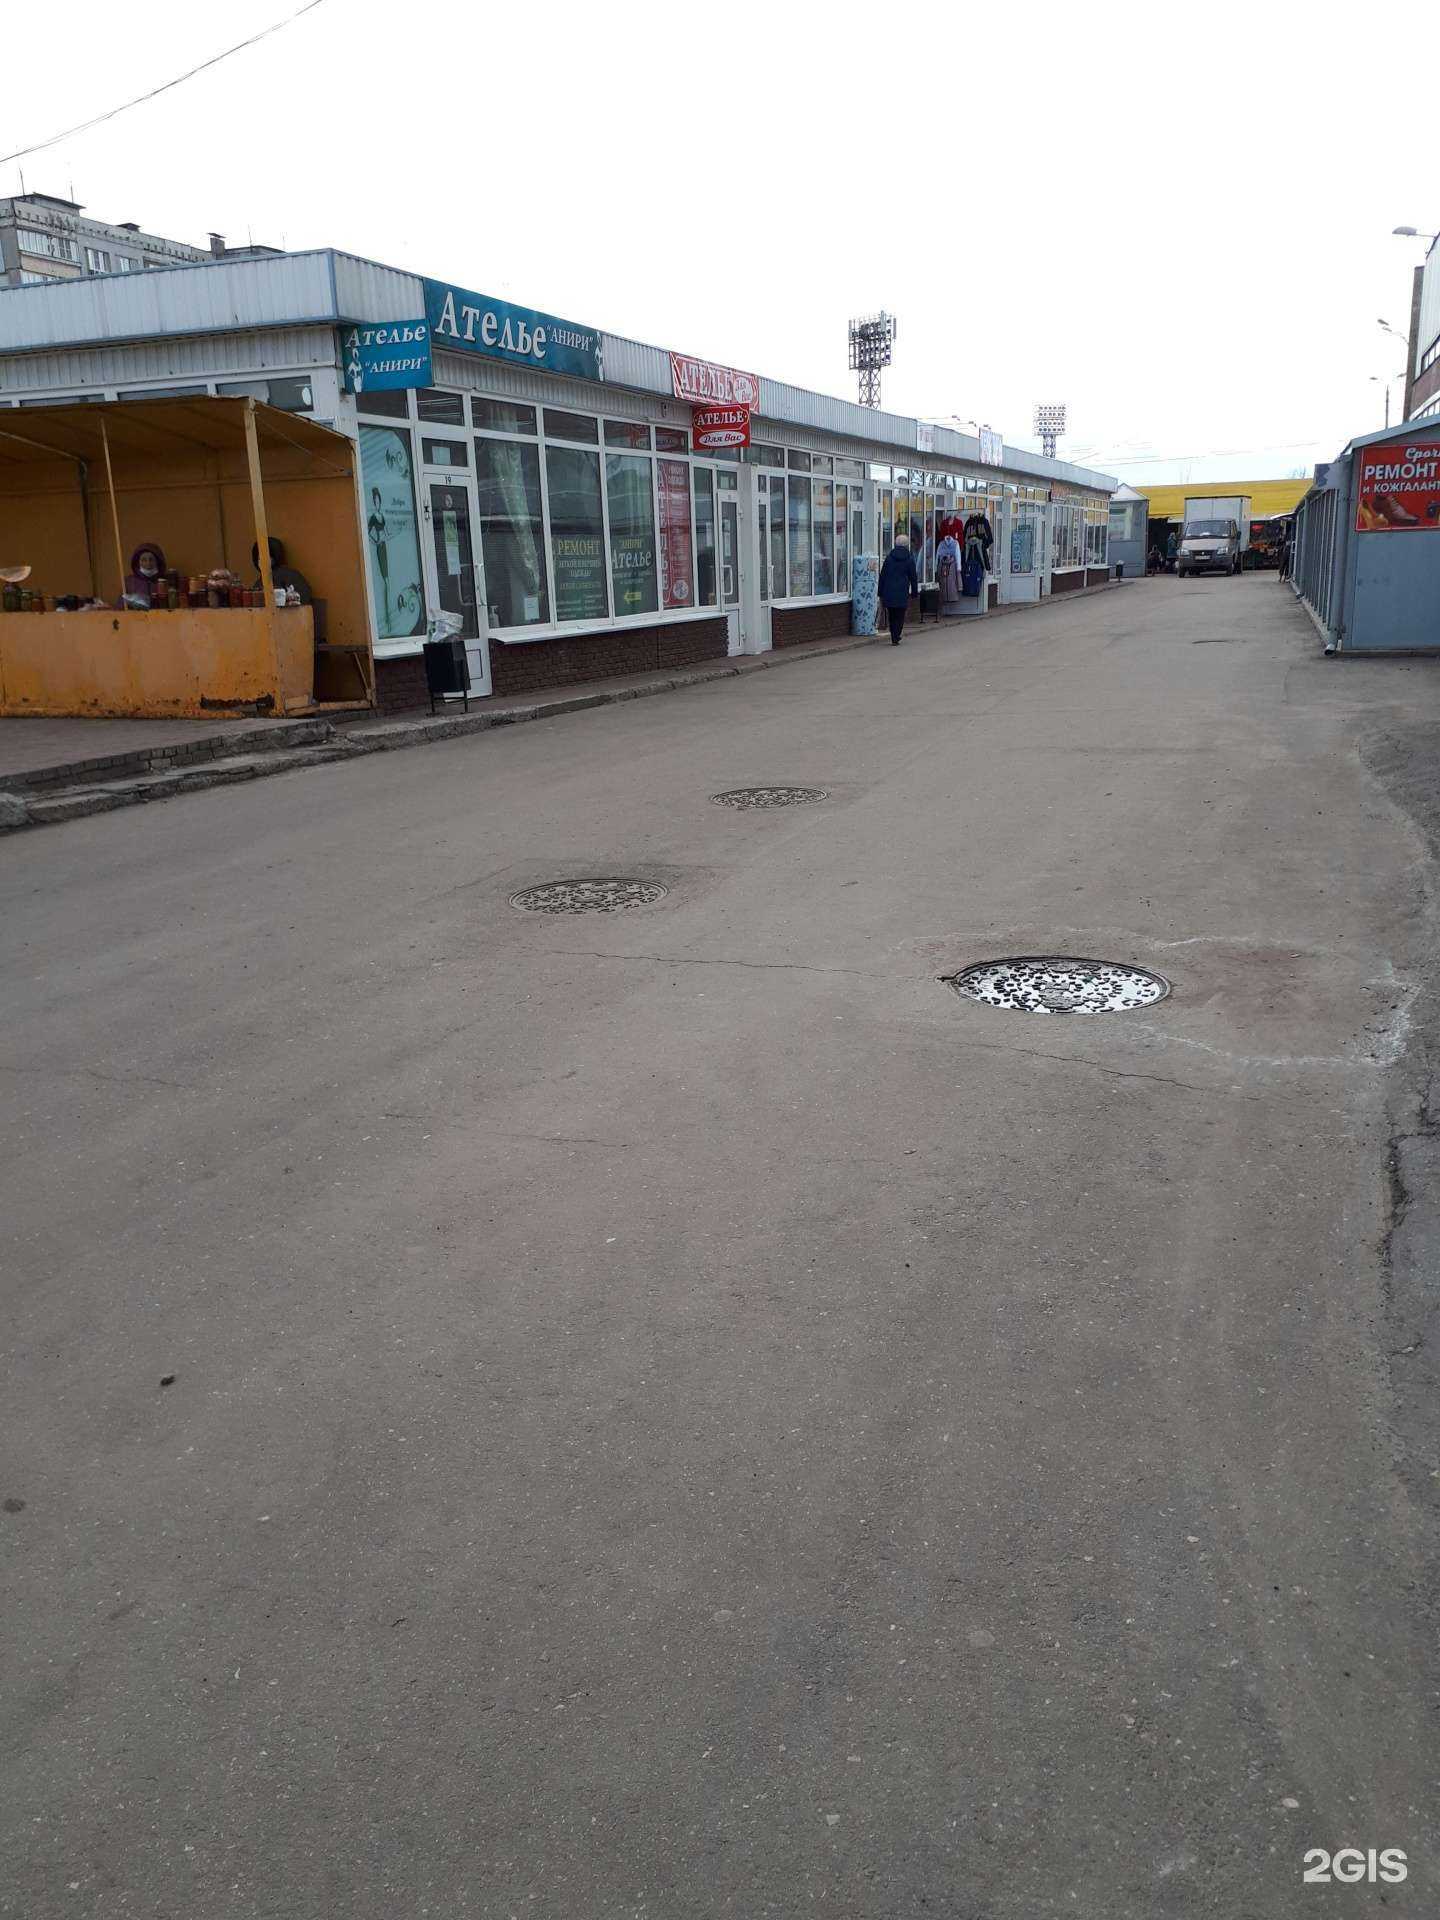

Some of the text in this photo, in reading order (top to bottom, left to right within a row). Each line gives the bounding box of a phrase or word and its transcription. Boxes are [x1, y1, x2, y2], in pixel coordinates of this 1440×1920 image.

[434, 291, 547, 358] Ателье
[345, 326, 426, 347] Ателье
[365, 357, 428, 373] "АНИРИ"
[681, 361, 733, 401] АТЕЛЬЕ
[698, 411, 744, 425] АТЕЛЬЕ
[1364, 463, 1438, 481] РЕМОНТ
[611, 549, 652, 569] Ателье
